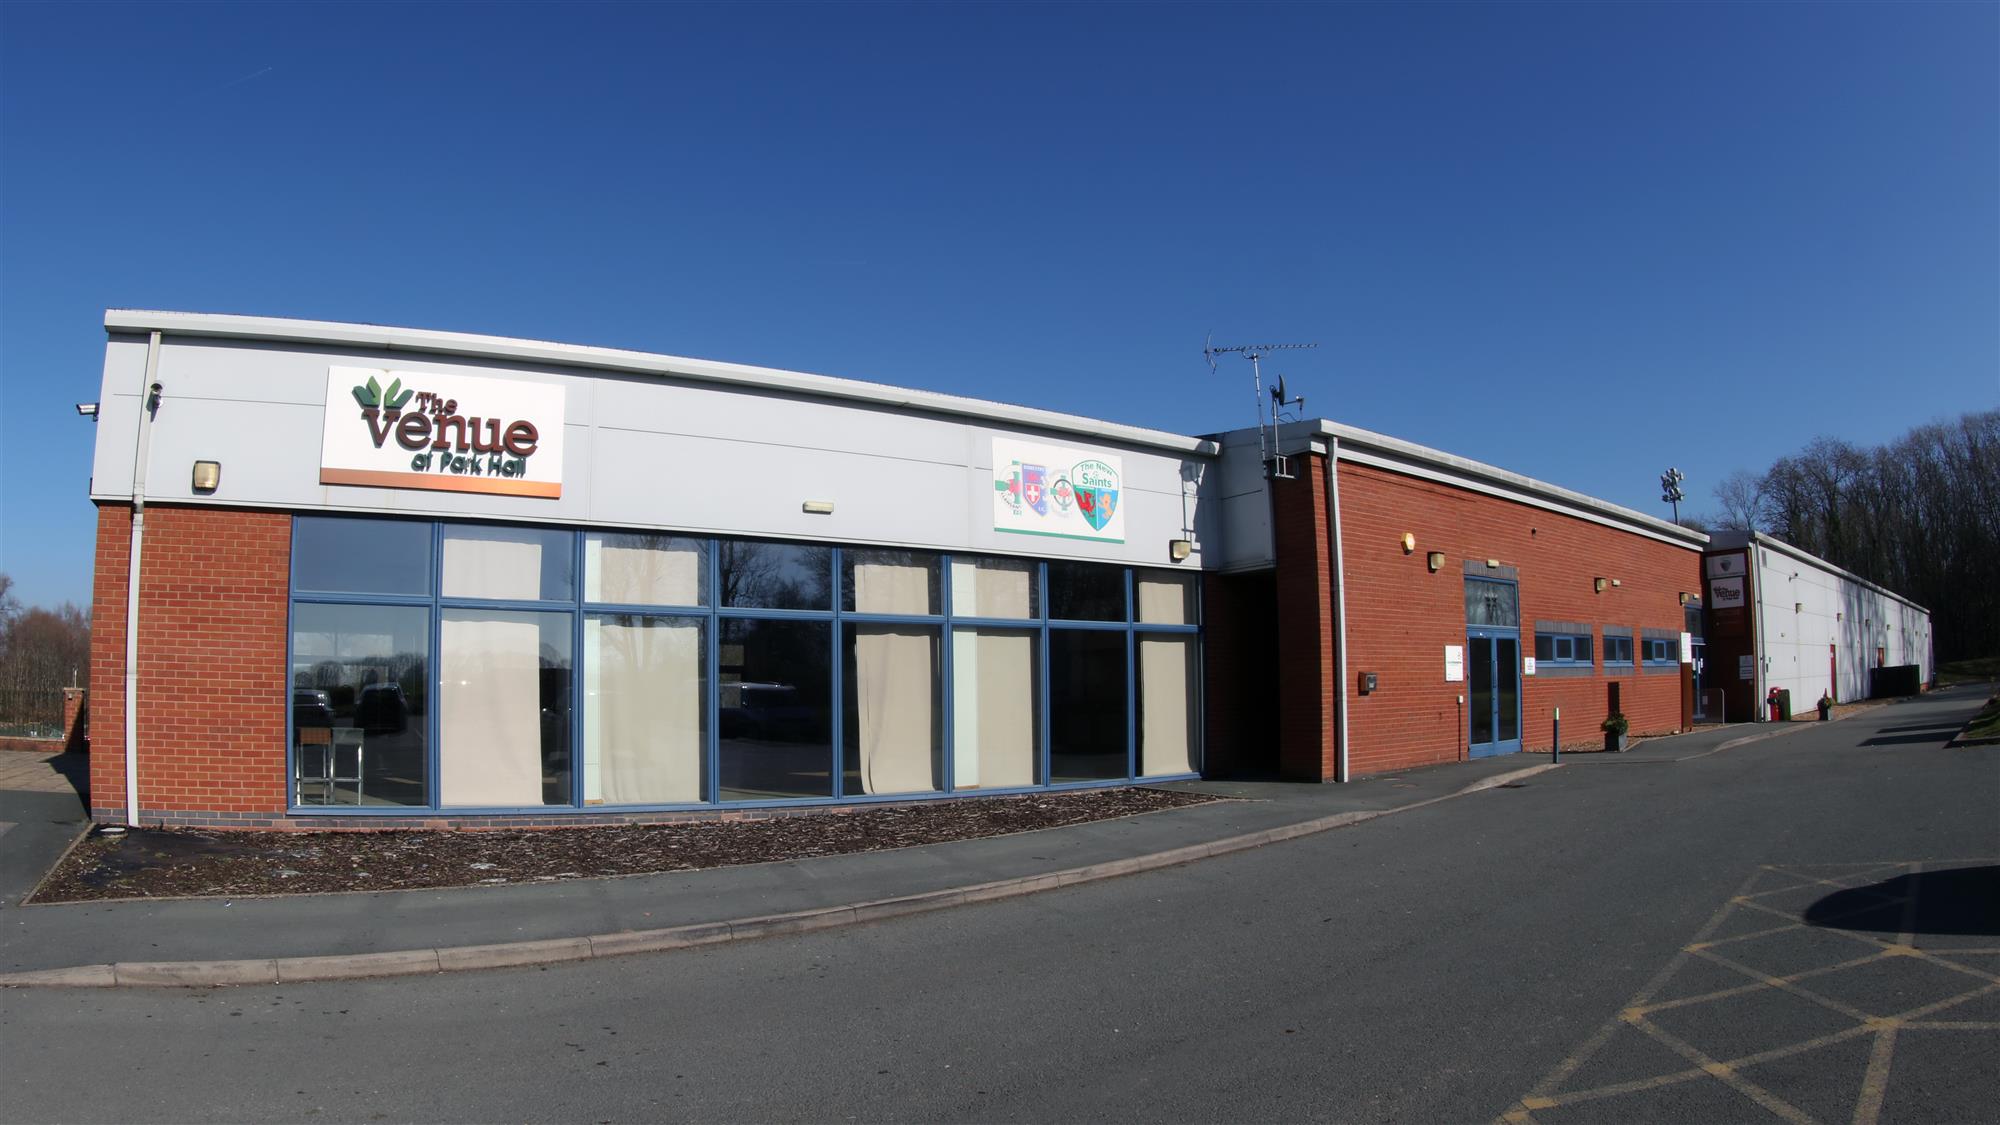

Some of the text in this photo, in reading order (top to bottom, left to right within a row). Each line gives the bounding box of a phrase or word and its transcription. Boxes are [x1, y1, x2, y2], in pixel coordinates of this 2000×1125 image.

[416, 391, 457, 415] The
[411, 451, 527, 479] at Park Hall
[1080, 463, 1113, 476] The New
[1082, 472, 1112, 488] Saints
